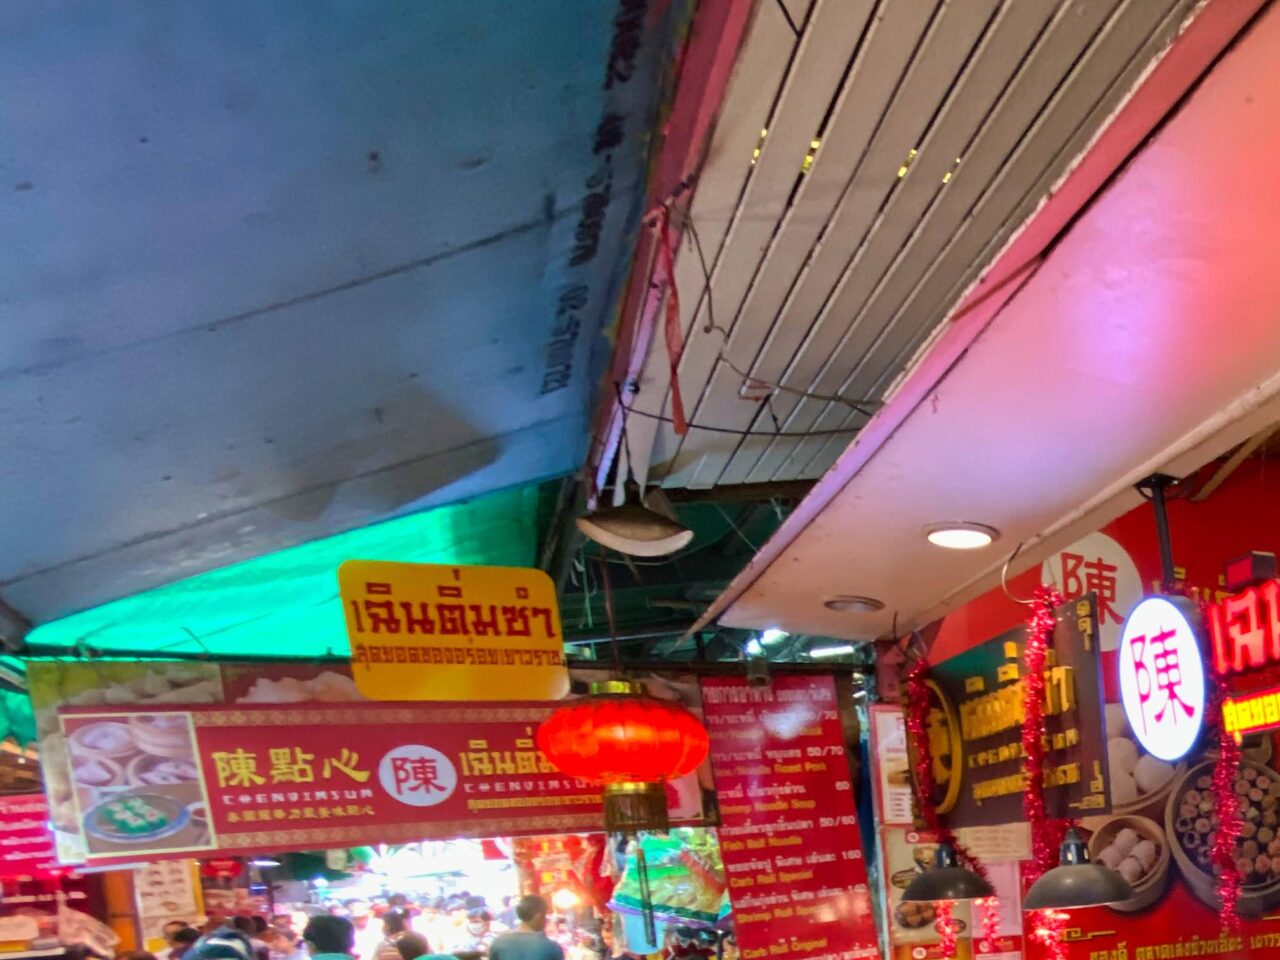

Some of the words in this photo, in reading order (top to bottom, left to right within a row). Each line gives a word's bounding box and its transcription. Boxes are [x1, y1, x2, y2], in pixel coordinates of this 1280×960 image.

[1061, 552, 1125, 625] 陳
[1130, 625, 1196, 736] 陳
[211, 746, 371, 788] 陳點心
[390, 756, 448, 796] 陳
[459, 726, 561, 777] เฉินติ่ม
